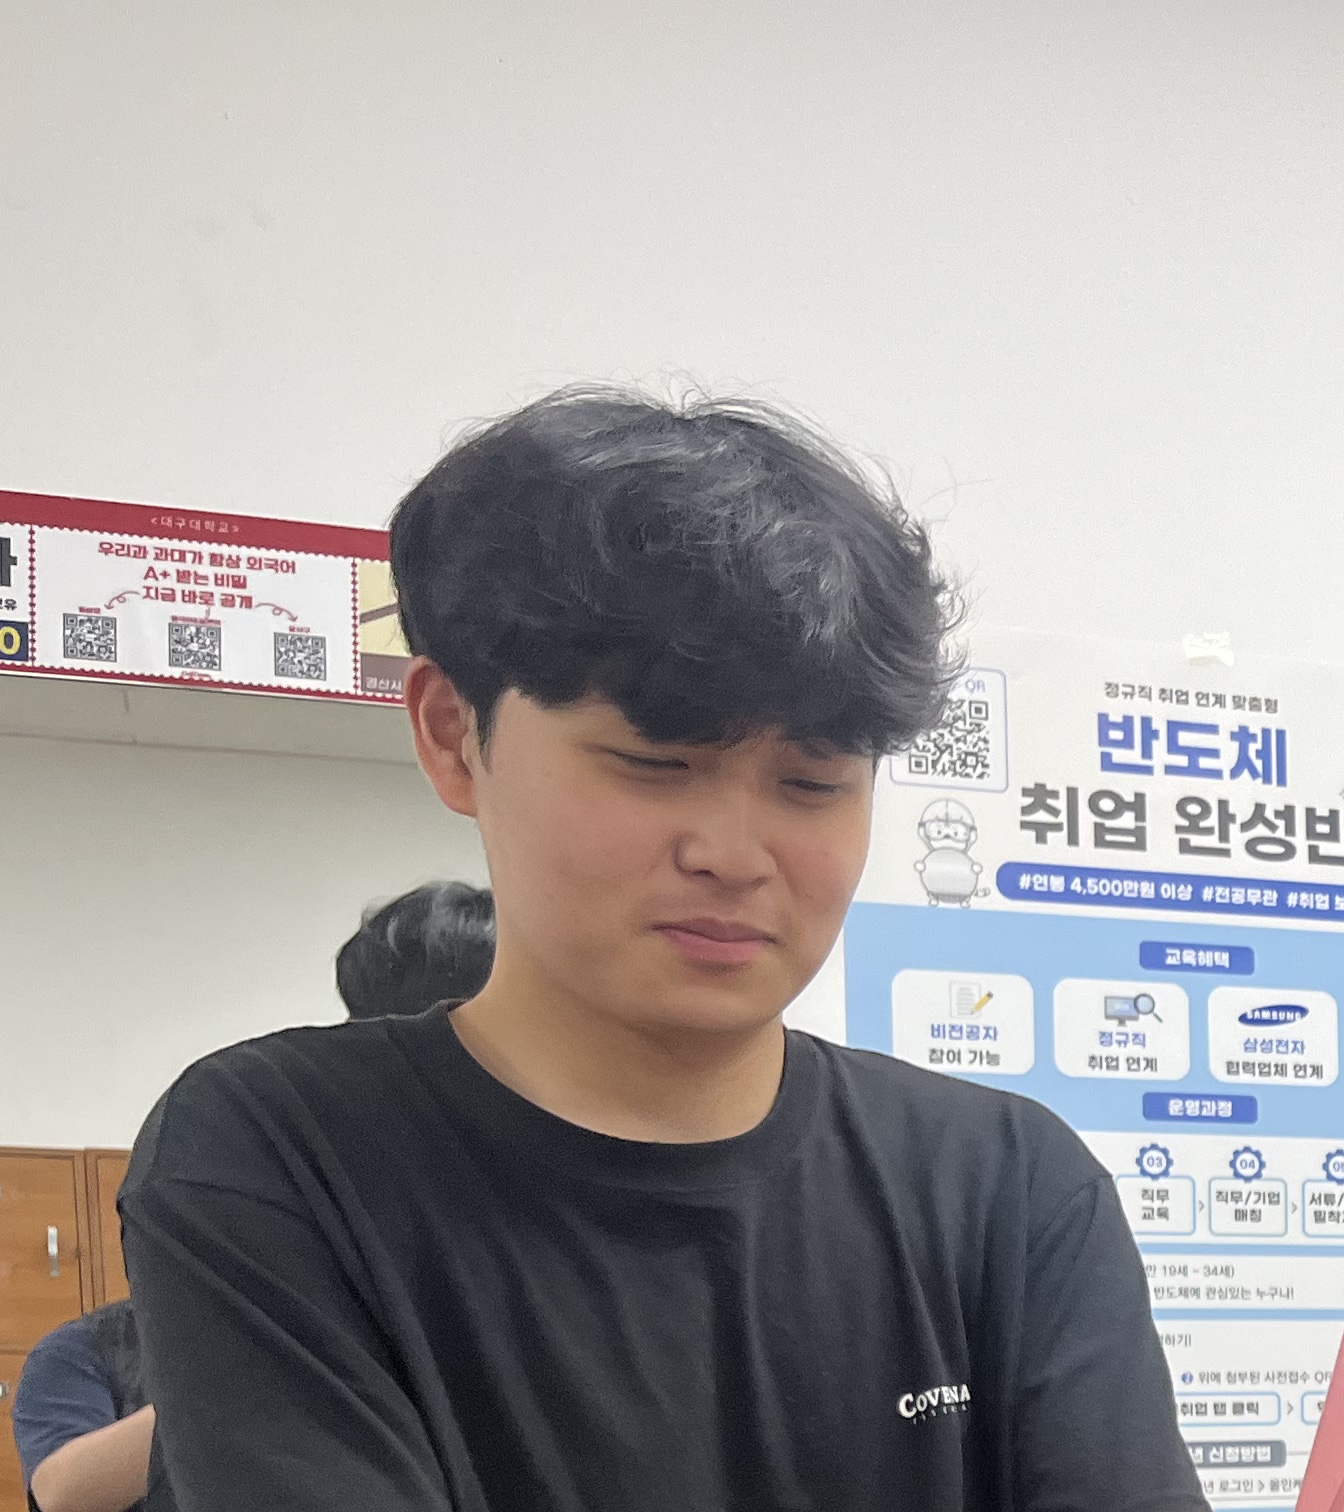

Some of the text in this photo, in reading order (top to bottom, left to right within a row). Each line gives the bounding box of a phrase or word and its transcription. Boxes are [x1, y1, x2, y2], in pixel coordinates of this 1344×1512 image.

[143, 566, 171, 581] A+
[246, 556, 296, 575] 외국어
[142, 585, 176, 602] 지금
[181, 589, 215, 607] 바로
[1105, 682, 1278, 714] 정규직 취업 연계 맞춤형
[1097, 712, 1287, 787] 반도체
[1020, 783, 1147, 852] 취업
[1019, 873, 1065, 892] #연봉
[1070, 877, 1155, 899] 4,500만원
[1161, 884, 1193, 901] 이상
[1202, 886, 1278, 907] #전공무관
[1286, 892, 1329, 910] #취업
[1165, 948, 1230, 968] 교육혜택
[930, 1023, 998, 1042] 비전공자
[1099, 1030, 1147, 1049] 정규직
[1243, 1037, 1305, 1056] 삼성전자
[968, 1050, 1001, 1067] 가능
[1088, 1055, 1158, 1073] 취업 연계
[1225, 1061, 1324, 1080] 협력업체 연계
[1168, 1098, 1233, 1118] 운영과정
[1146, 1156, 1163, 1168] 03
[1239, 1158, 1256, 1170] 04
[1141, 1188, 1170, 1203] 직무
[1215, 1190, 1281, 1206] 직무/기업
[1141, 1207, 1170, 1221] 교육
[1205, 1286, 1252, 1300] 관심있는
[1264, 1371, 1310, 1385] 사전접수
